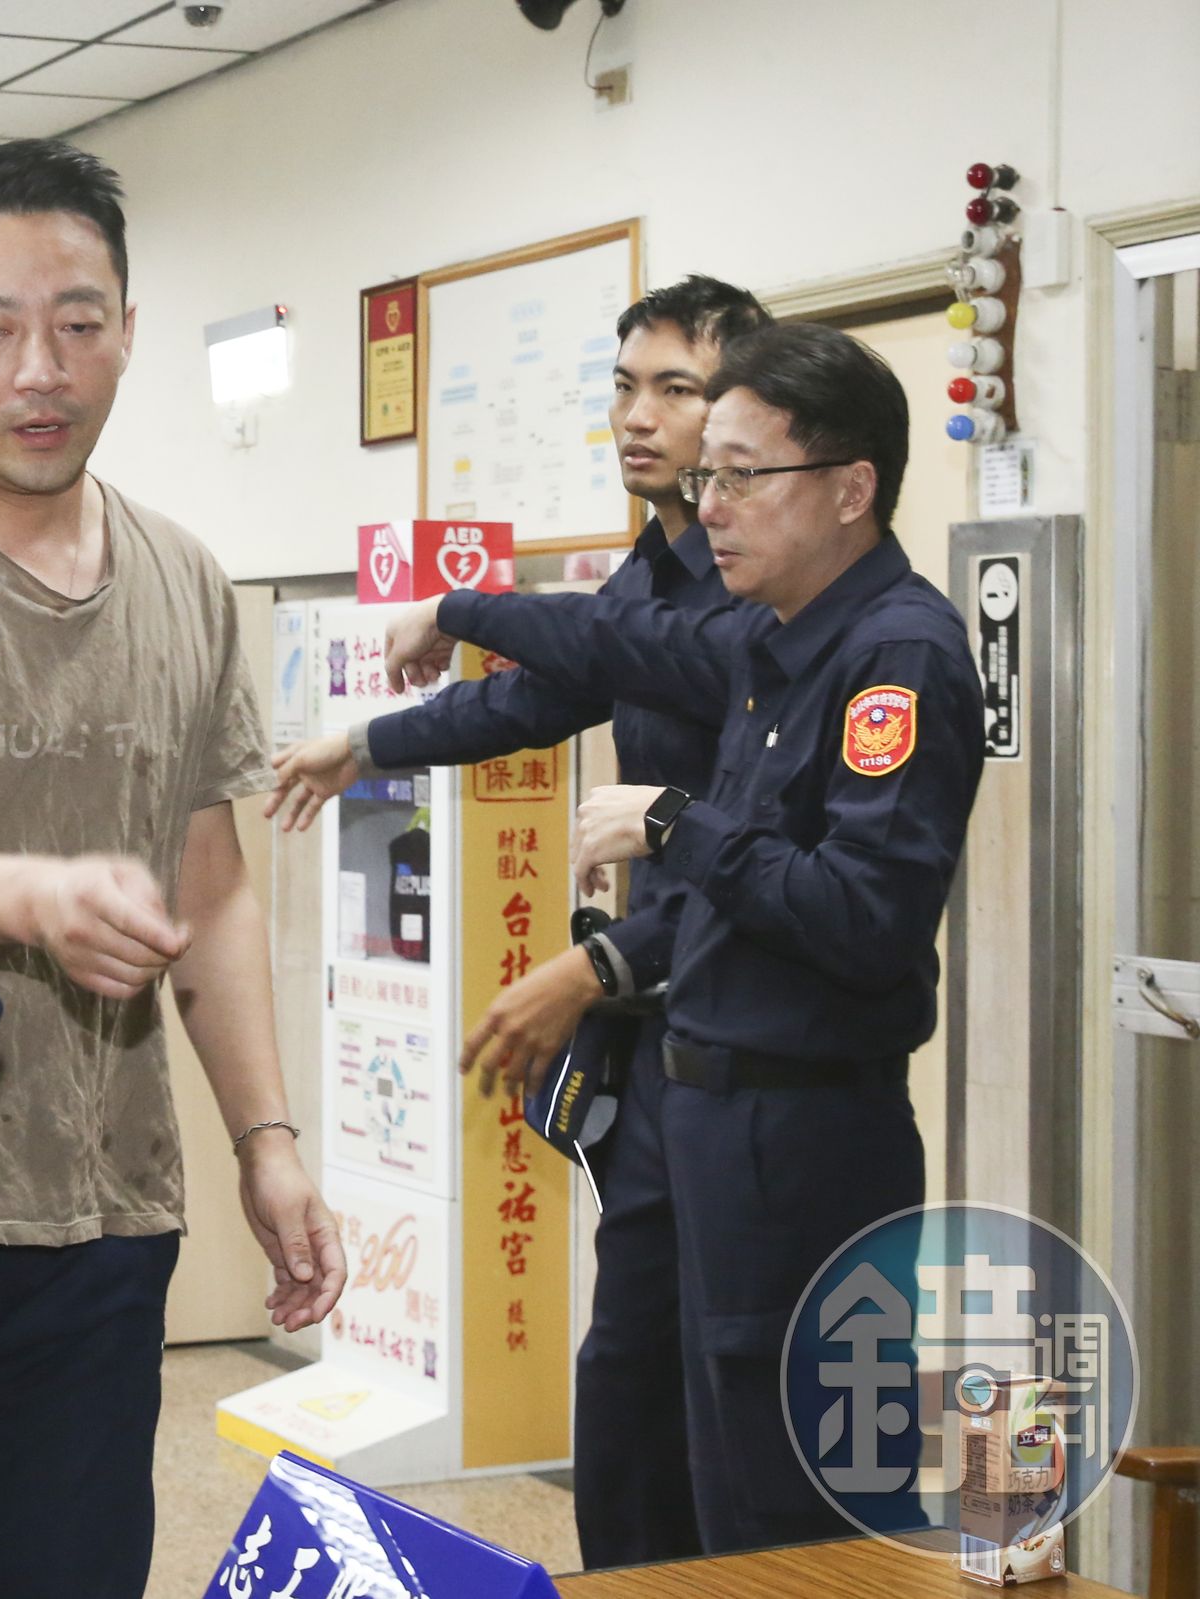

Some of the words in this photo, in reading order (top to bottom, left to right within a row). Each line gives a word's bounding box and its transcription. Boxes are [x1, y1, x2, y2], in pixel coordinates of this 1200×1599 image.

[373, 529, 388, 544] AE
[444, 527, 483, 544] AED
[1007, 1466, 1050, 1493] 巧克力
[1007, 1494, 1035, 1517] 奶茶
